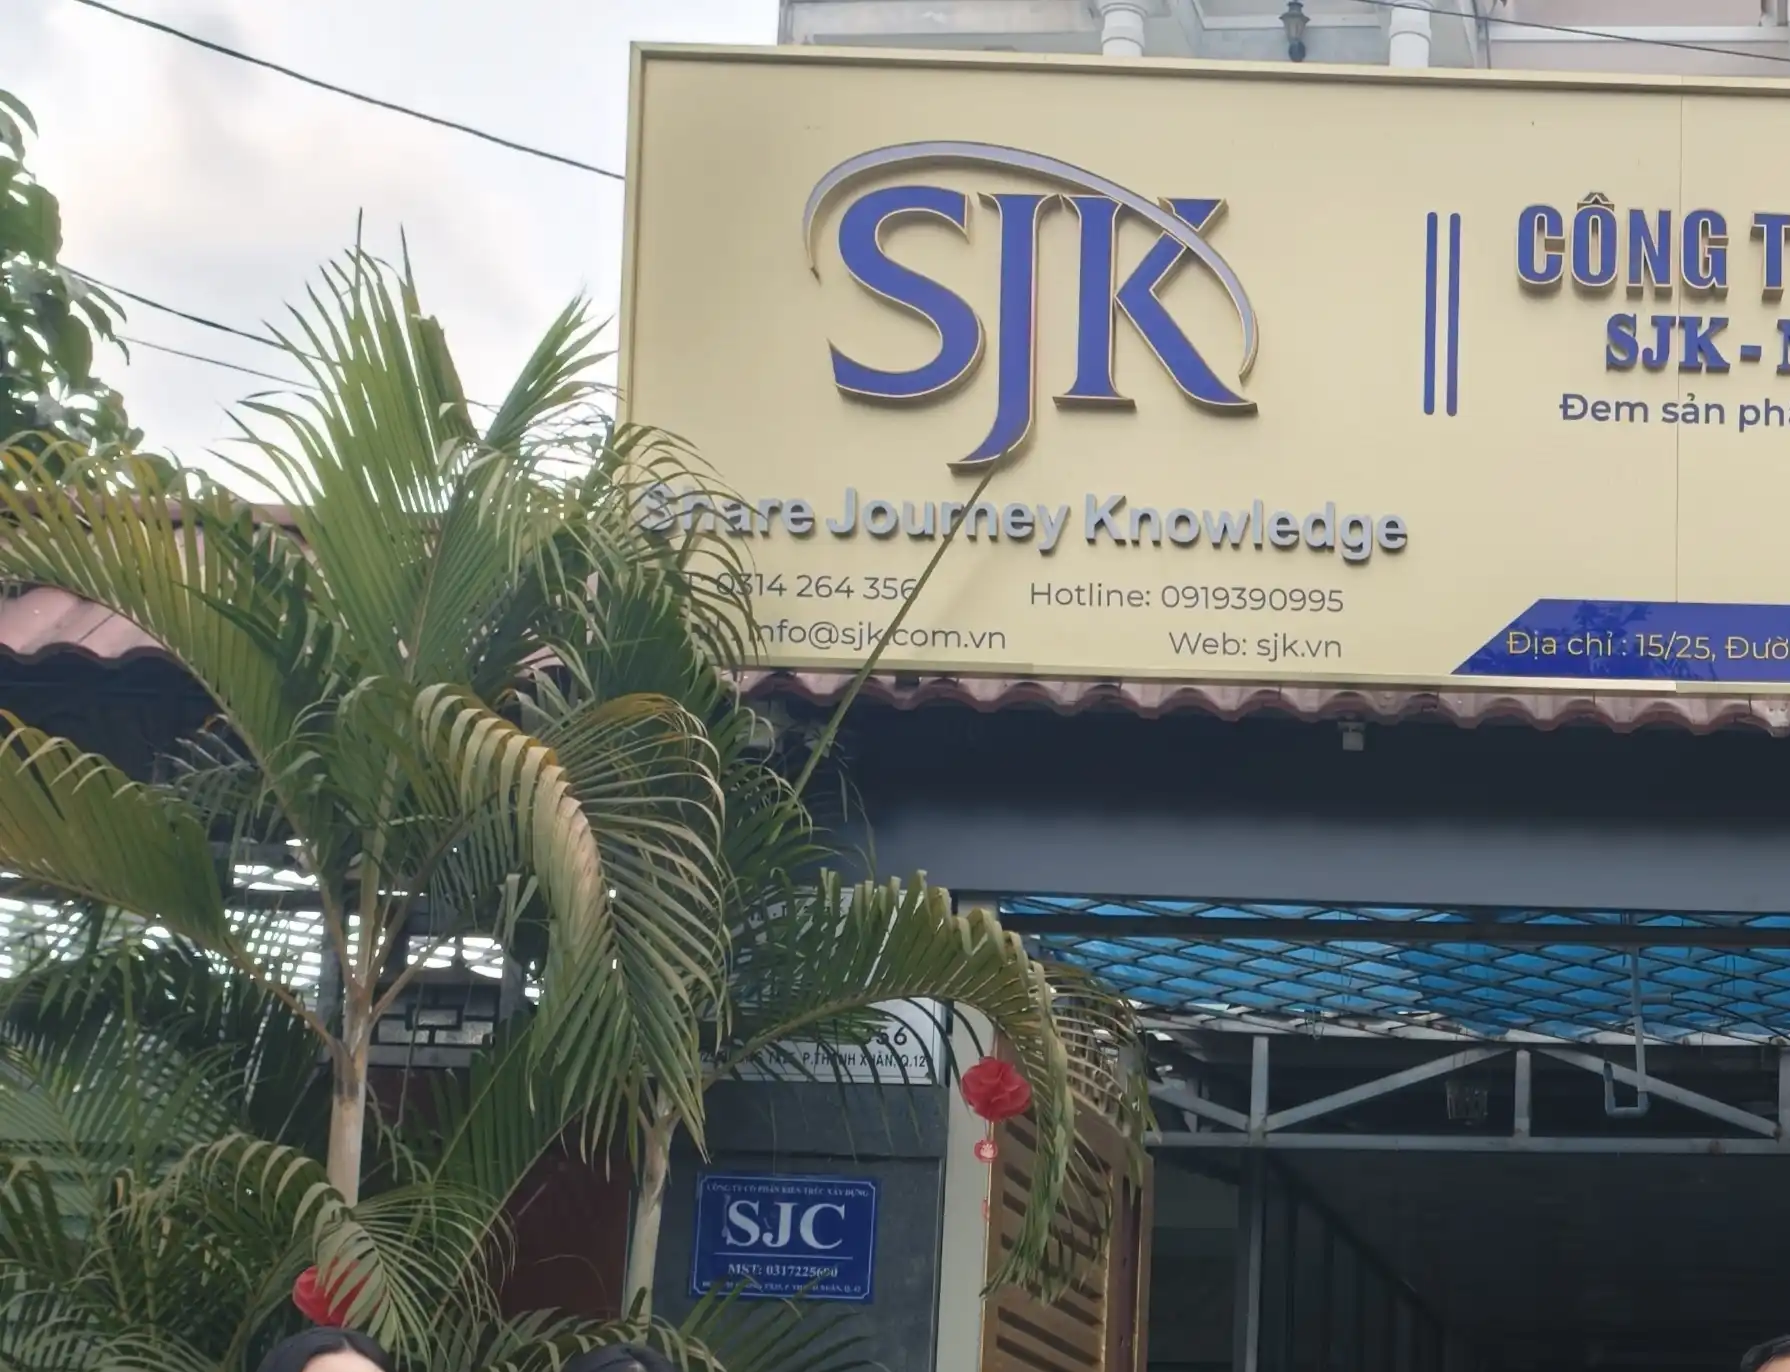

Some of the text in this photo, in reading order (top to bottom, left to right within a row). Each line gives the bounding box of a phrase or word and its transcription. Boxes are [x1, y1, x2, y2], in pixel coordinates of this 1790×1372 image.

[1516, 191, 1729, 299] CÔNG
[827, 184, 1258, 476] SJK
[1605, 312, 1731, 374] SJK
[1559, 393, 1649, 423] Đem
[1660, 393, 1726, 426] sản
[635, 482, 1409, 566] Share Journey Knowledge
[716, 571, 788, 599] 0314
[796, 574, 855, 600] 264
[862, 576, 920, 601] 356
[1029, 580, 1344, 614] Hotline: 0919390995
[1169, 630, 1343, 664] Web: sjk.vn
[1506, 630, 1557, 662] Địa
[1566, 627, 1613, 657] chỉ
[1635, 632, 1717, 662] 15/25,
[726, 1200, 845, 1250] SJC
